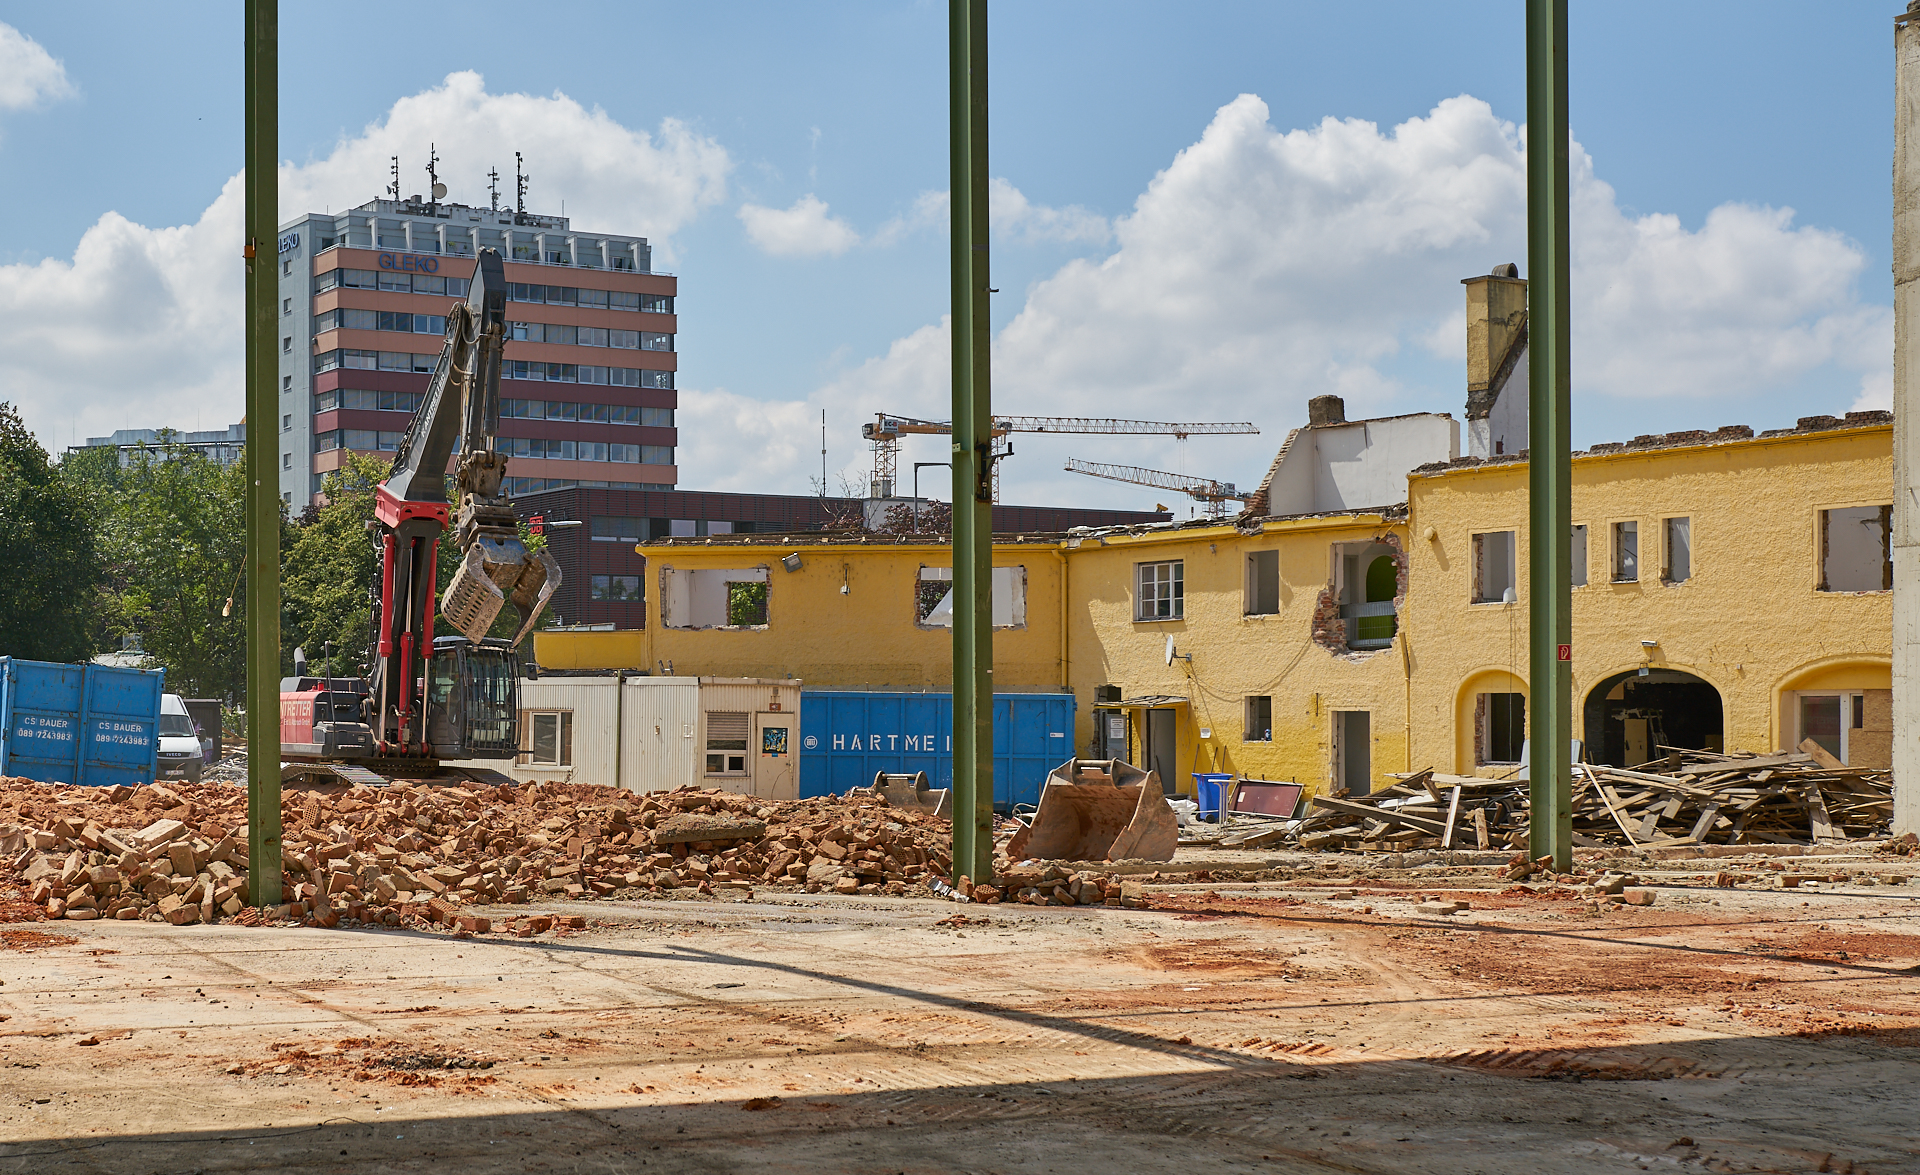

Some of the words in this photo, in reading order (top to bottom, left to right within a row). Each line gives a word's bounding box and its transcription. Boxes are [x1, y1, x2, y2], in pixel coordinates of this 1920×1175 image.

[278, 232, 299, 253] LEKO
[379, 253, 439, 273] GLEKO
[280, 701, 311, 716] NTRETTER
[24, 717, 36, 725] CS
[40, 719, 68, 728] BAUER
[98, 721, 110, 730] CS
[114, 723, 142, 732] BAUER
[18, 729, 33, 737] 089
[37, 730, 71, 741] 7243983
[95, 734, 110, 742] 089
[833, 734, 950, 751] HARTMEI
